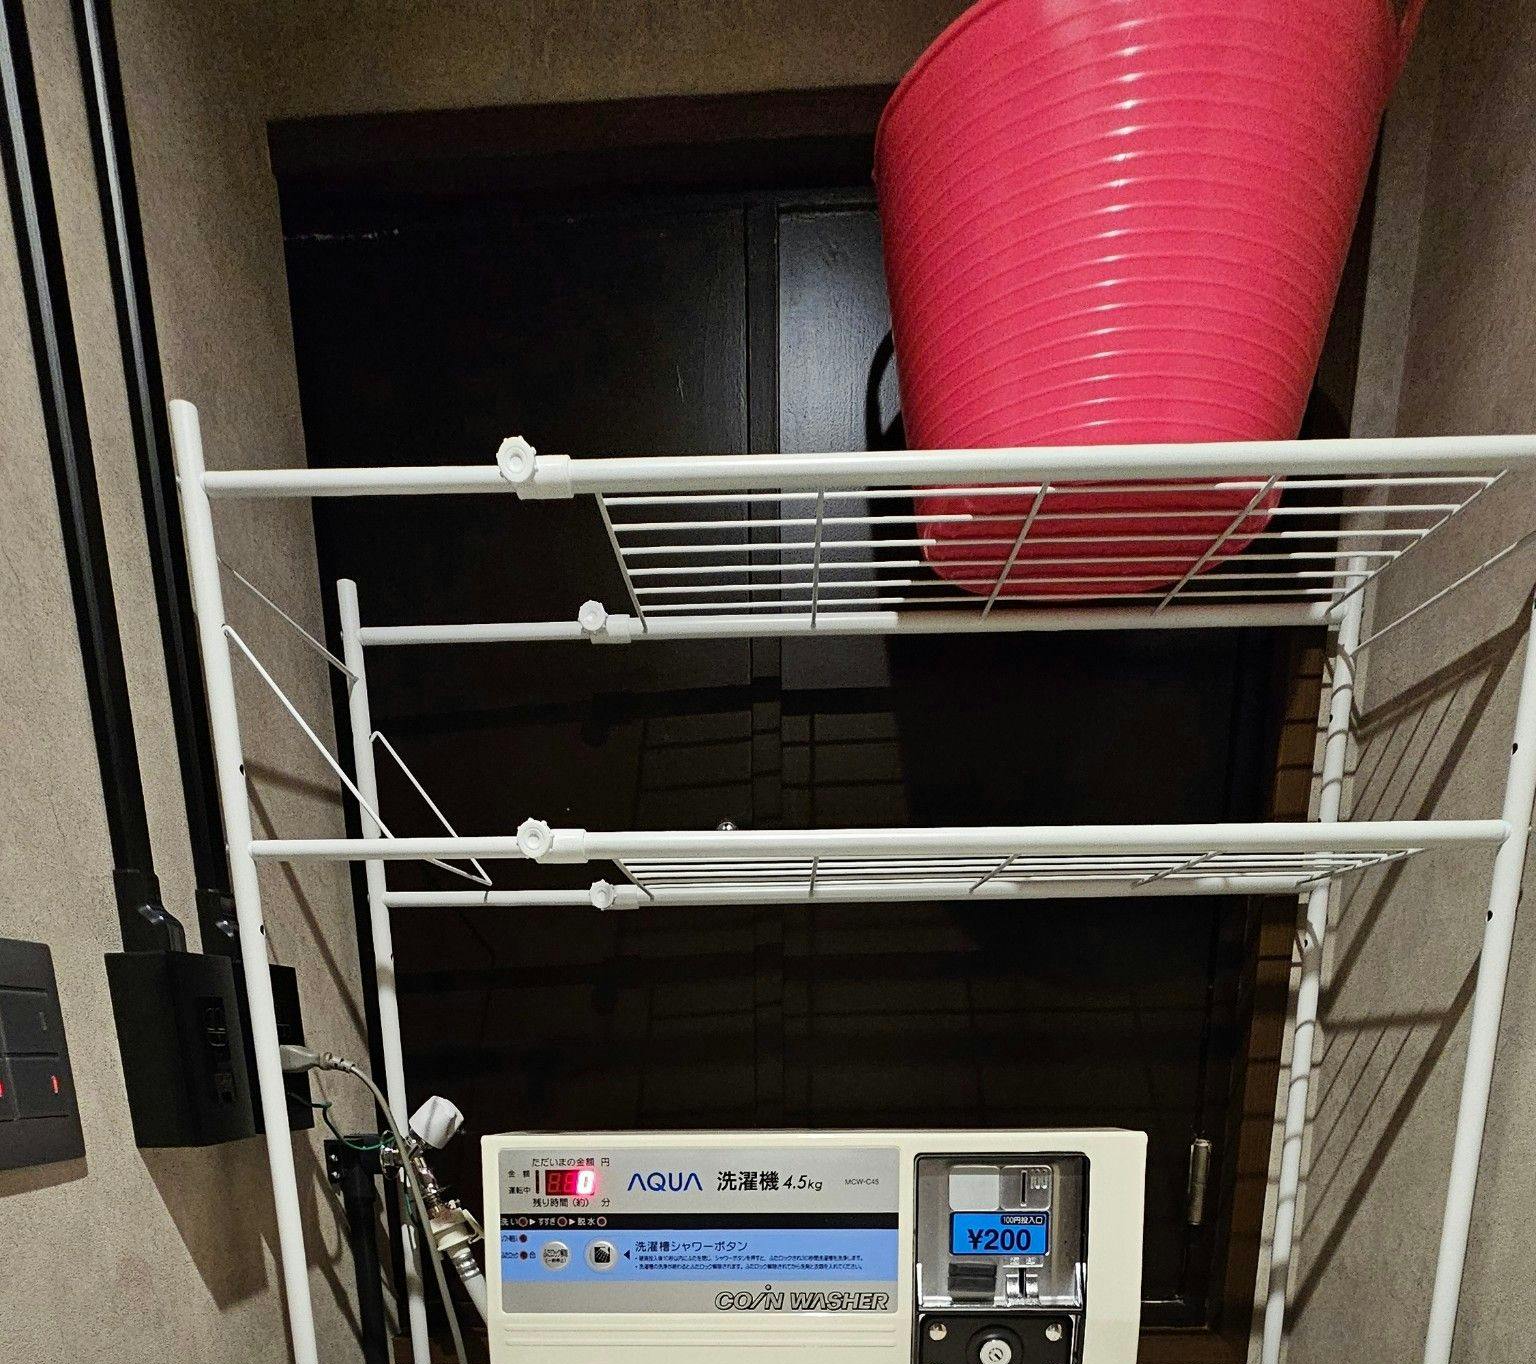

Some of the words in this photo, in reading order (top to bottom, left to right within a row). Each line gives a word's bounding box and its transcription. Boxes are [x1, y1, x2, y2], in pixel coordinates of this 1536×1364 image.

[532, 1157, 595, 1167] ただいまの金額
[600, 1157, 610, 1167] 円
[627, 1172, 704, 1191] AQUA
[717, 1170, 779, 1191] 洗濯機
[783, 1174, 823, 1192] 4.5kg
[601, 1198, 610, 1207] 分
[538, 1217, 556, 1226] すすぎ
[577, 1217, 596, 1226] 脱水
[1003, 1216, 1043, 1225] 100円投入口
[967, 1228, 1032, 1251] ¥200
[635, 1241, 748, 1252] 洗濯槽シャワーボタン
[790, 1291, 890, 1311] WASHER
